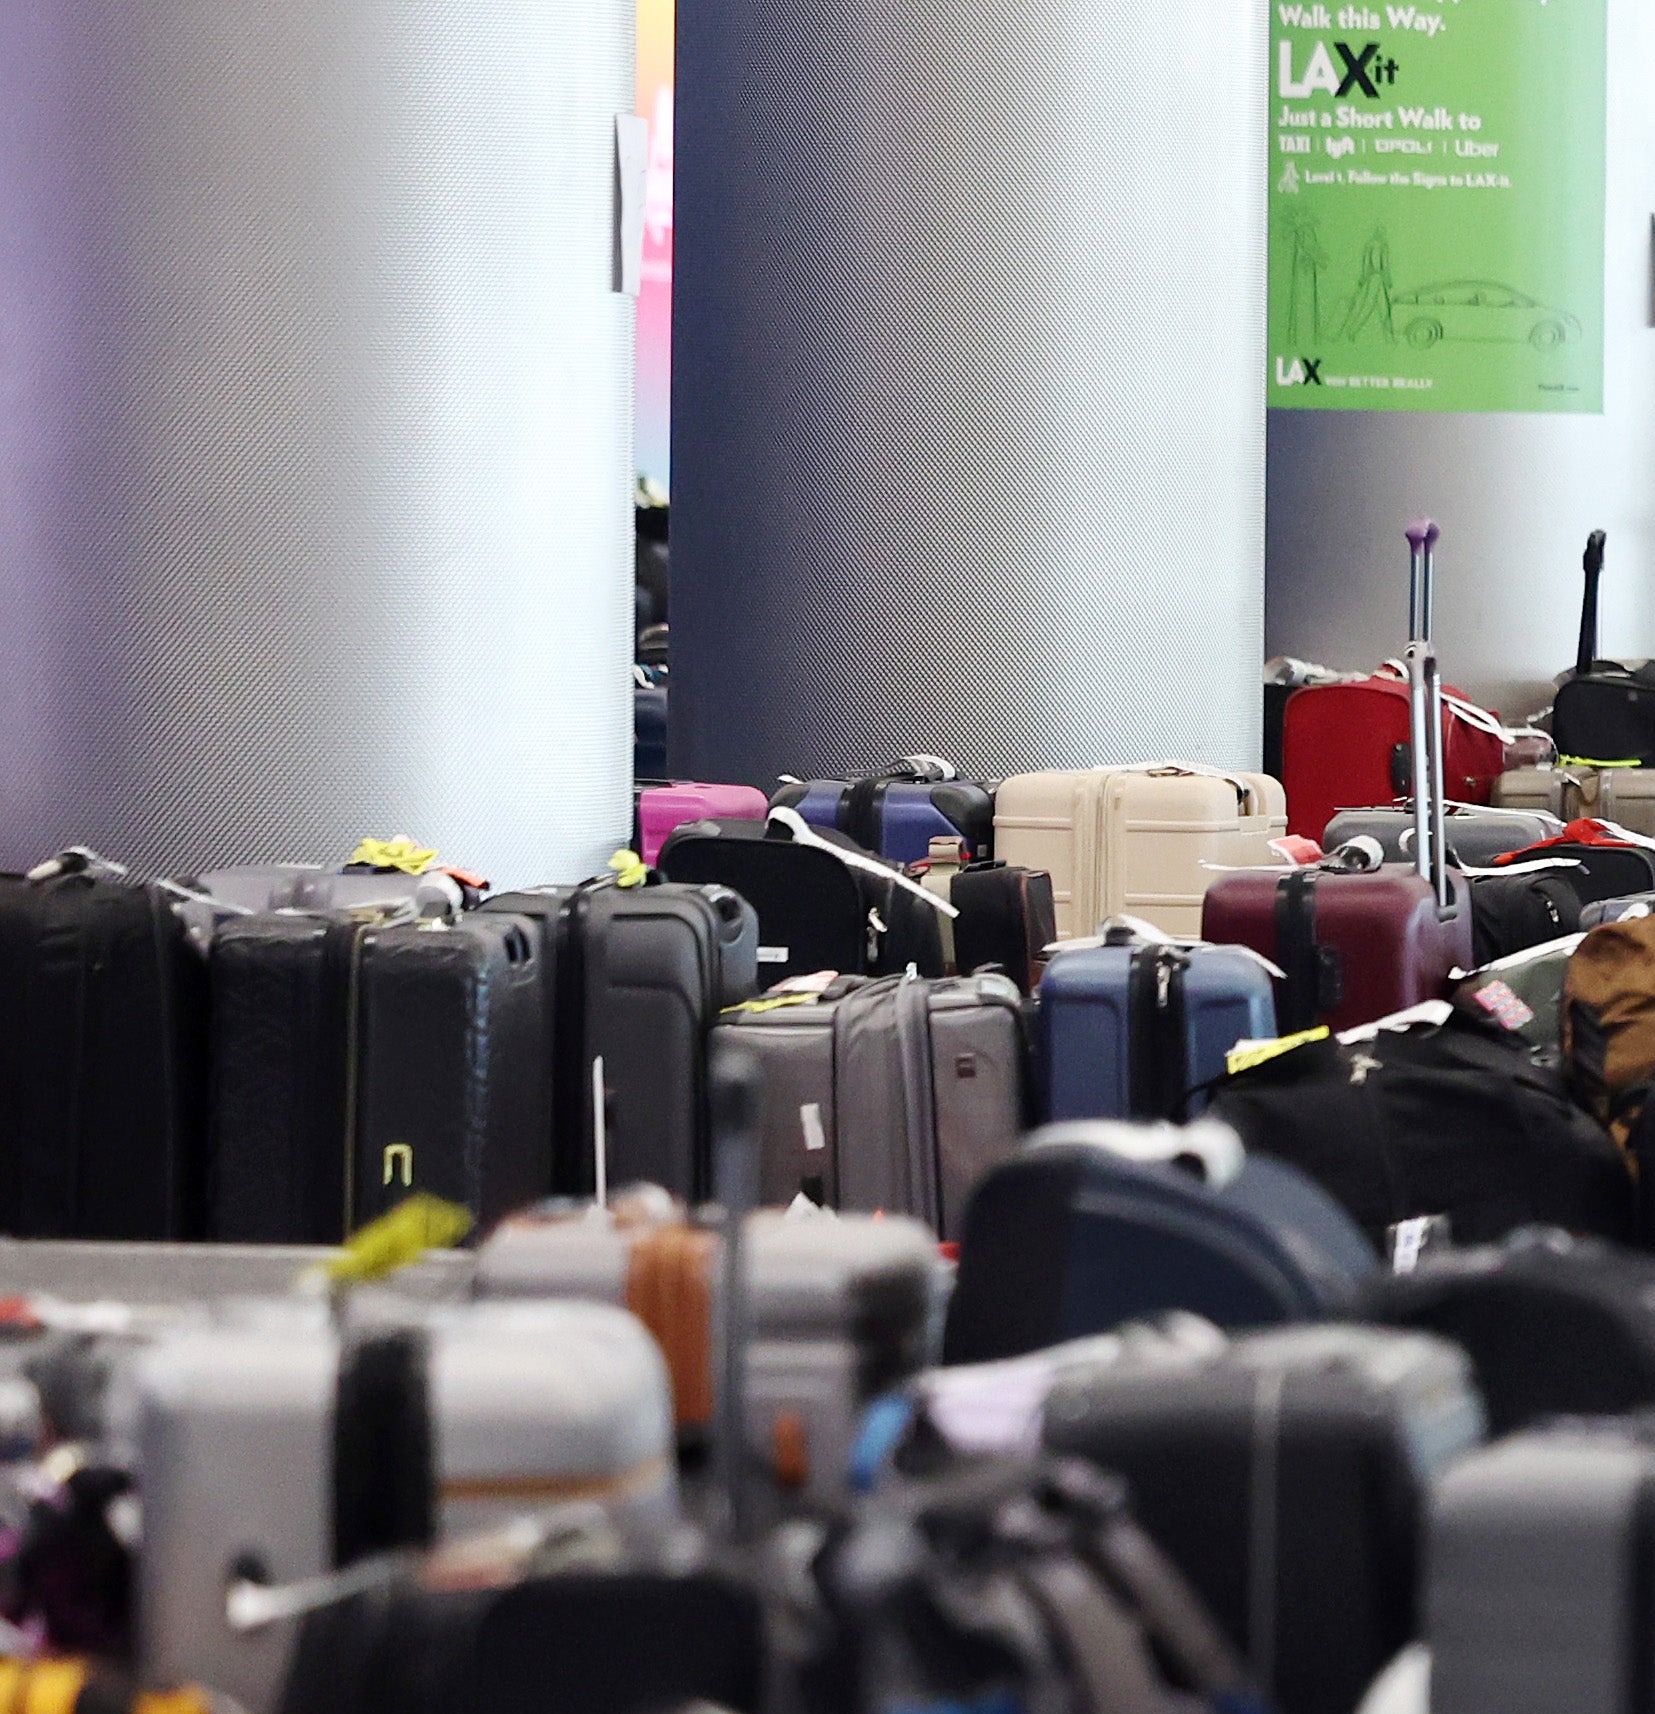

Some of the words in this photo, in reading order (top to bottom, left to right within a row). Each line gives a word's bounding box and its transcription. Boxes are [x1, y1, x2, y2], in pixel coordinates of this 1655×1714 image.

[1278, 4, 1331, 29] Walk
[1338, 5, 1381, 30] this
[1386, 6, 1447, 37] Way.
[1278, 40, 1399, 98] LAXit
[1278, 104, 1317, 128] Just
[1321, 112, 1332, 128] a
[1335, 105, 1393, 129] Short
[1398, 106, 1453, 130] Walk
[1458, 112, 1482, 131] to
[1455, 139, 1499, 158] Uber
[1275, 356, 1322, 386] LAX
